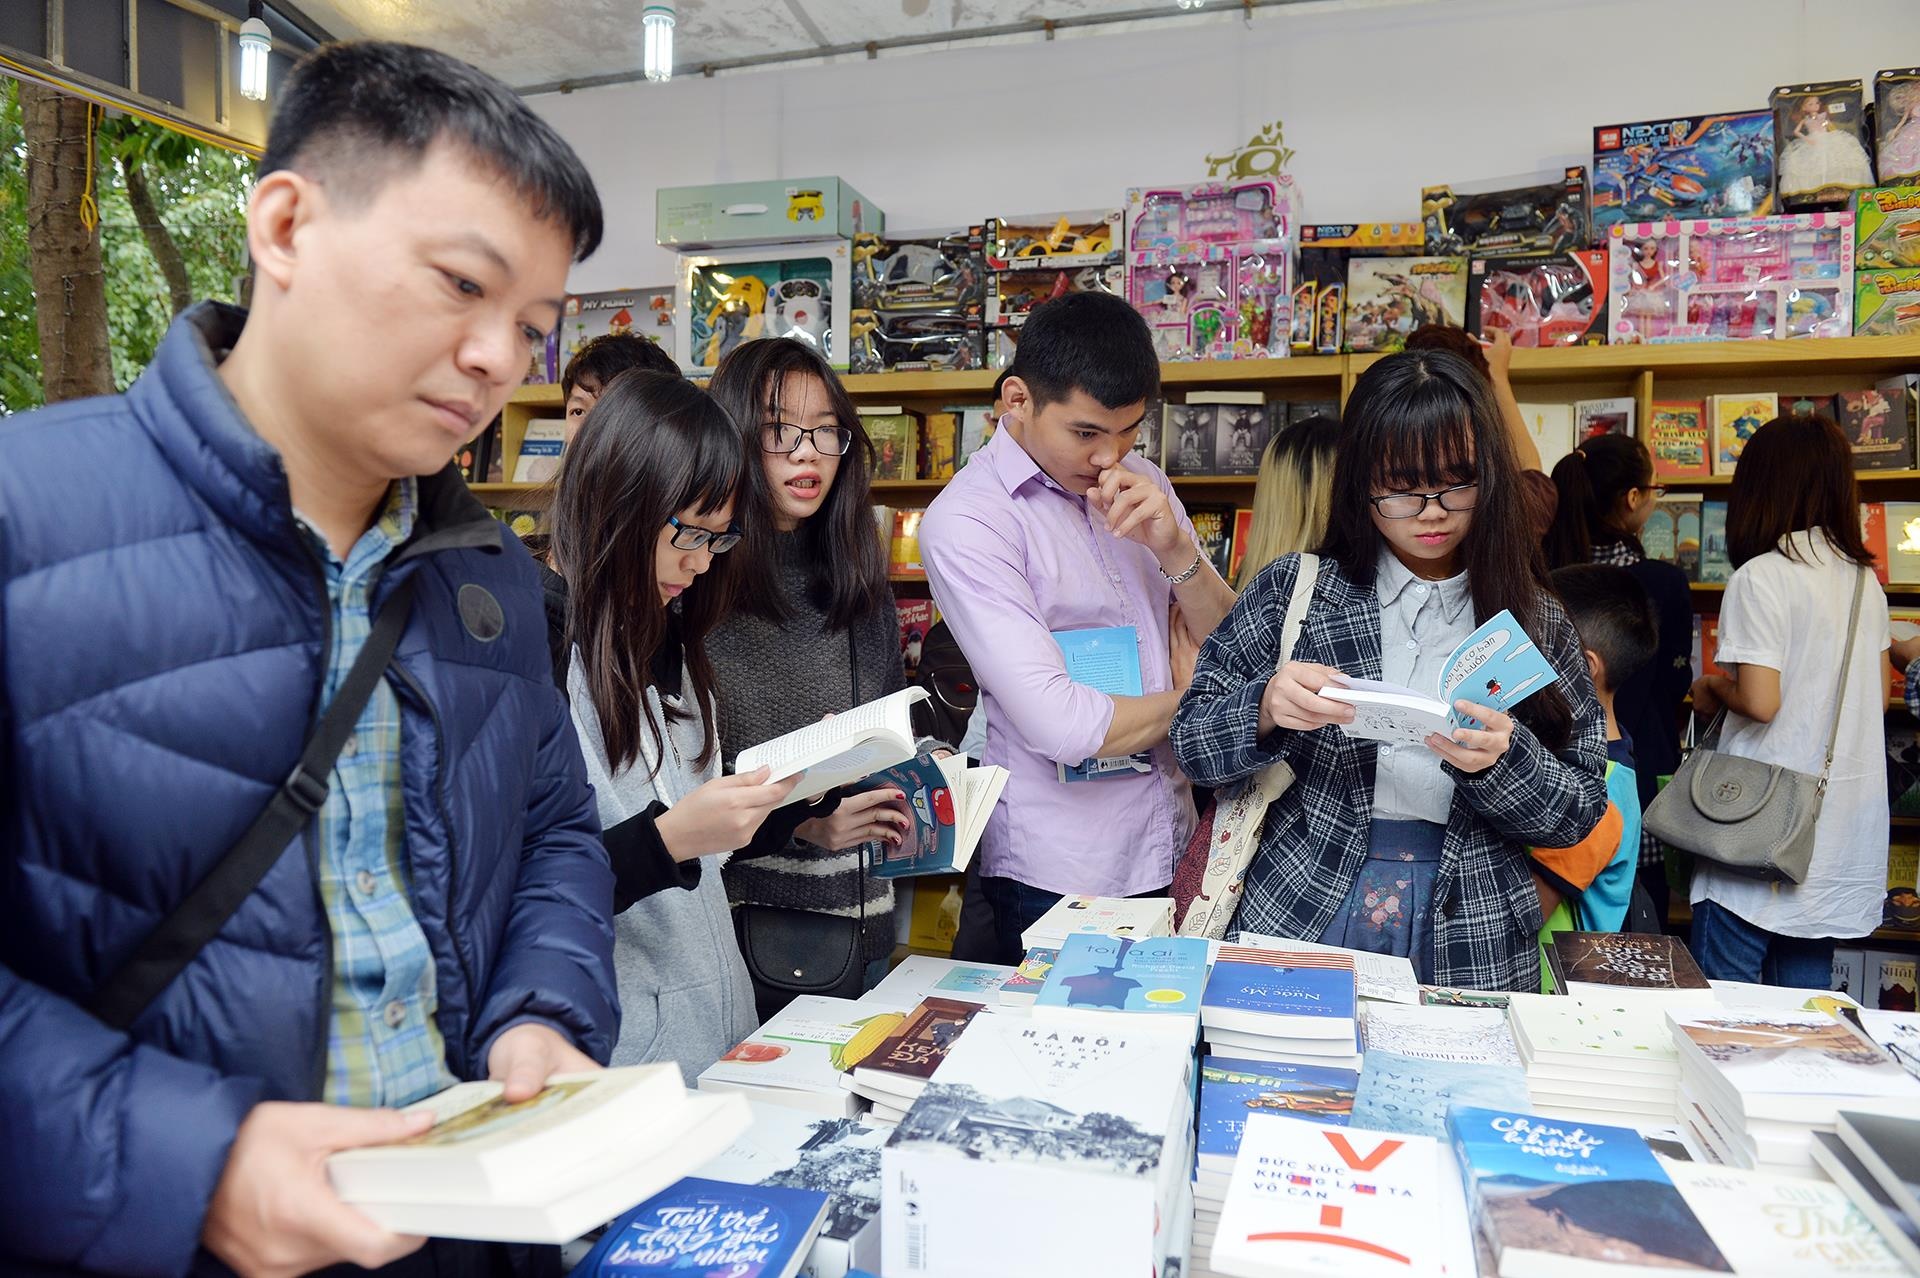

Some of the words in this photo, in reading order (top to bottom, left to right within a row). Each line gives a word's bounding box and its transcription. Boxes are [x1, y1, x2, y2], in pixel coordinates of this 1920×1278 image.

[1622, 122, 1670, 138] NEXT
[1286, 1186, 1328, 1200] CAN
[1389, 1186, 1414, 1198] TA
